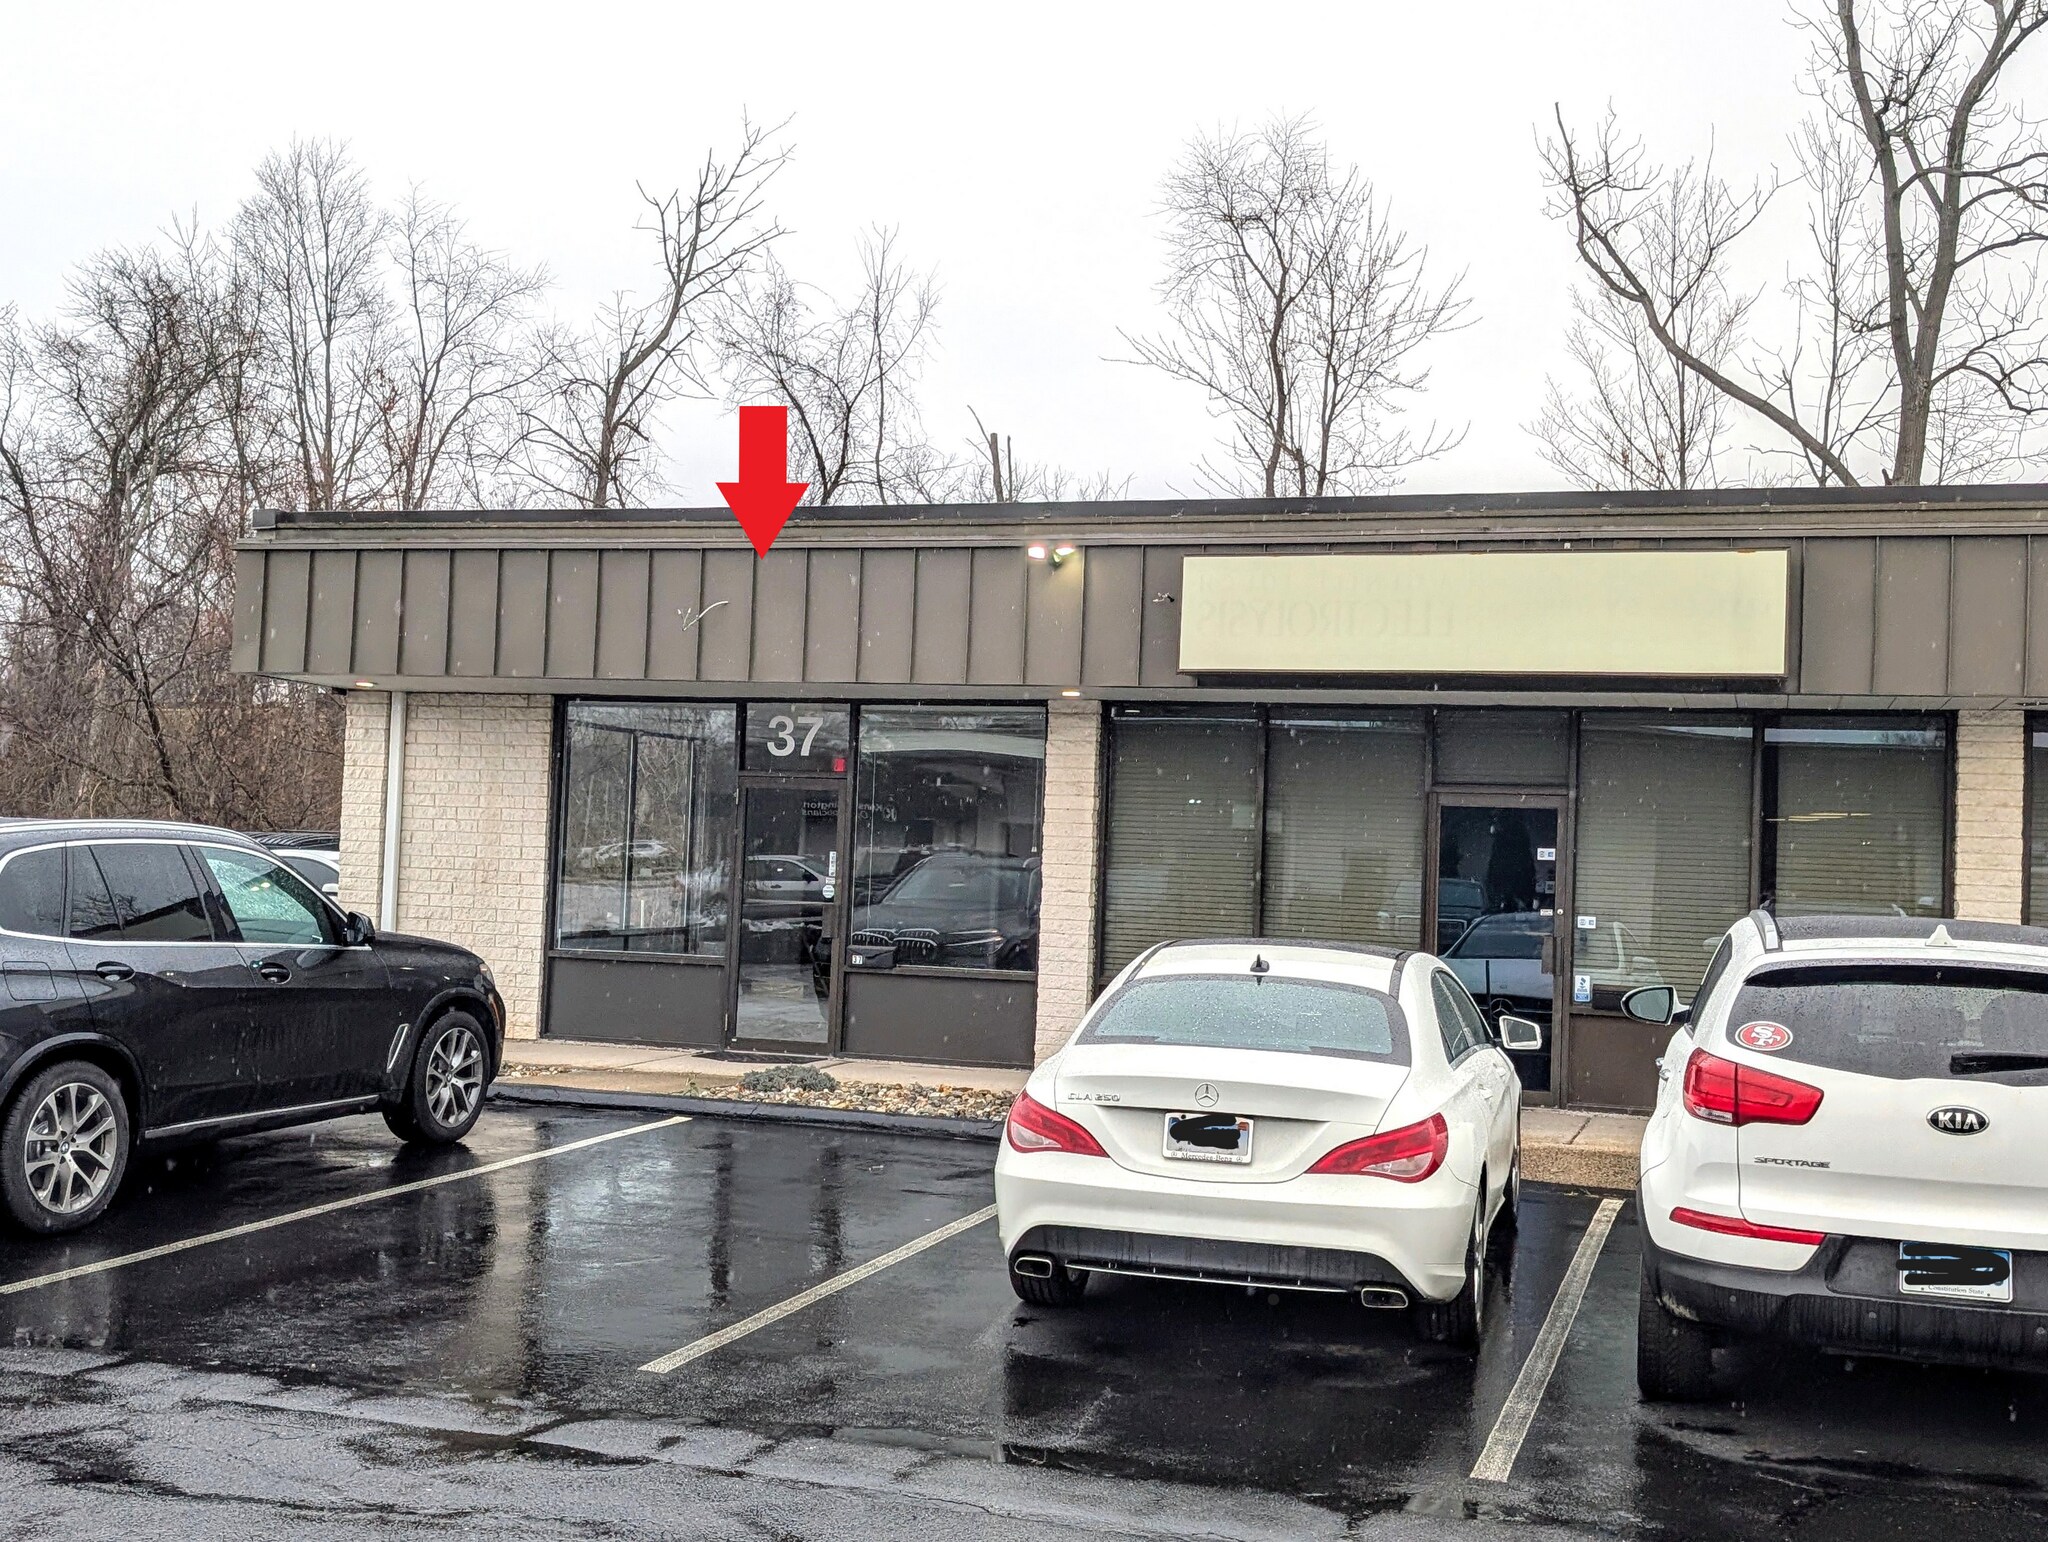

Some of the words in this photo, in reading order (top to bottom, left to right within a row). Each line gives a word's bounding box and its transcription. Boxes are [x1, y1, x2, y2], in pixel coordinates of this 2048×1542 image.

[767, 715, 823, 756] 37
[853, 955, 862, 964] 37
[1068, 1093, 1093, 1101] CLA
[1095, 1094, 1120, 1102] 250
[1938, 1111, 1980, 1130] KIA
[1754, 1157, 1831, 1169] SPORTAGE
[1968, 1287, 1985, 1296] State
